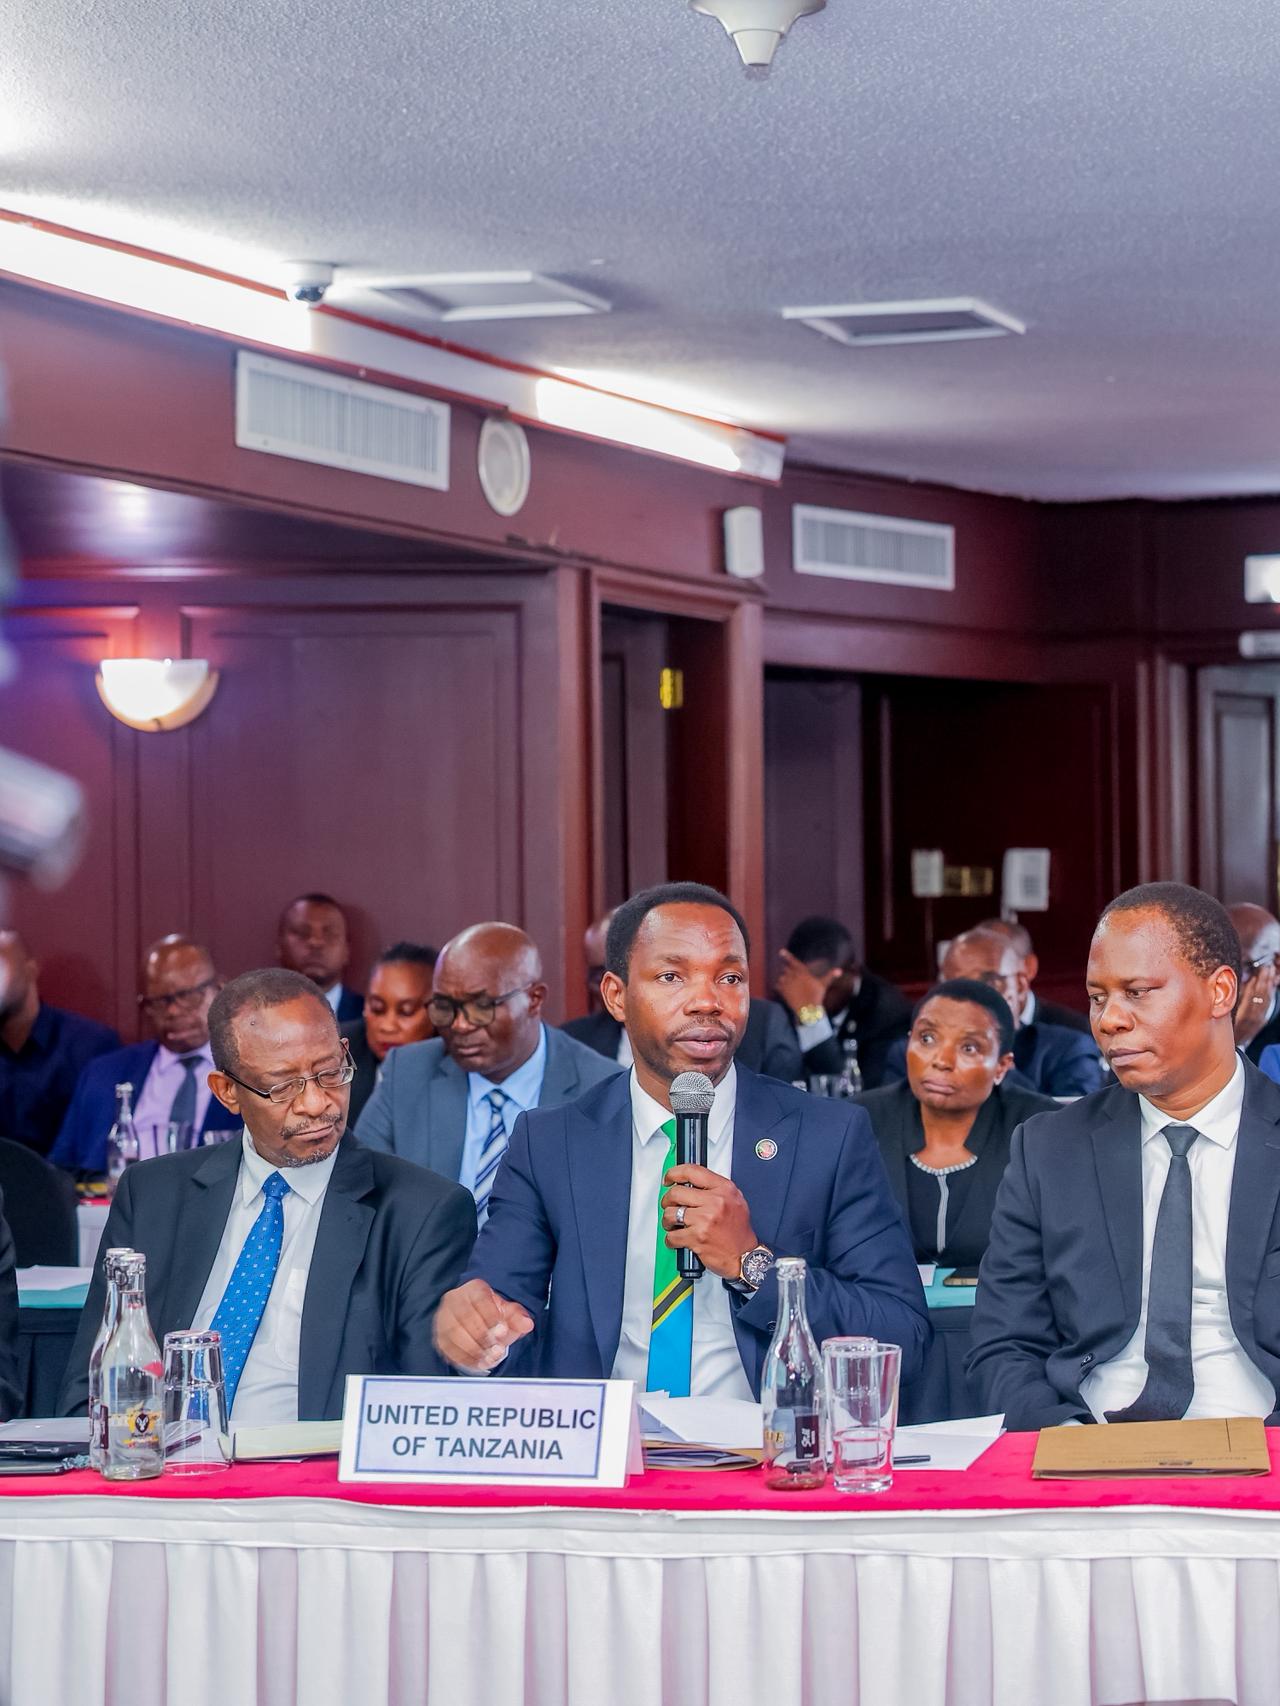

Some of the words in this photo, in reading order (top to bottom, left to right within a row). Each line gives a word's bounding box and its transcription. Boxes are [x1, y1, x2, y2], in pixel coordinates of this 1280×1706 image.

[366, 1404, 459, 1426] UNITED
[466, 1406, 596, 1429] REPUBLIC
[392, 1436, 427, 1457] OF
[434, 1437, 563, 1460] TANZANIA
